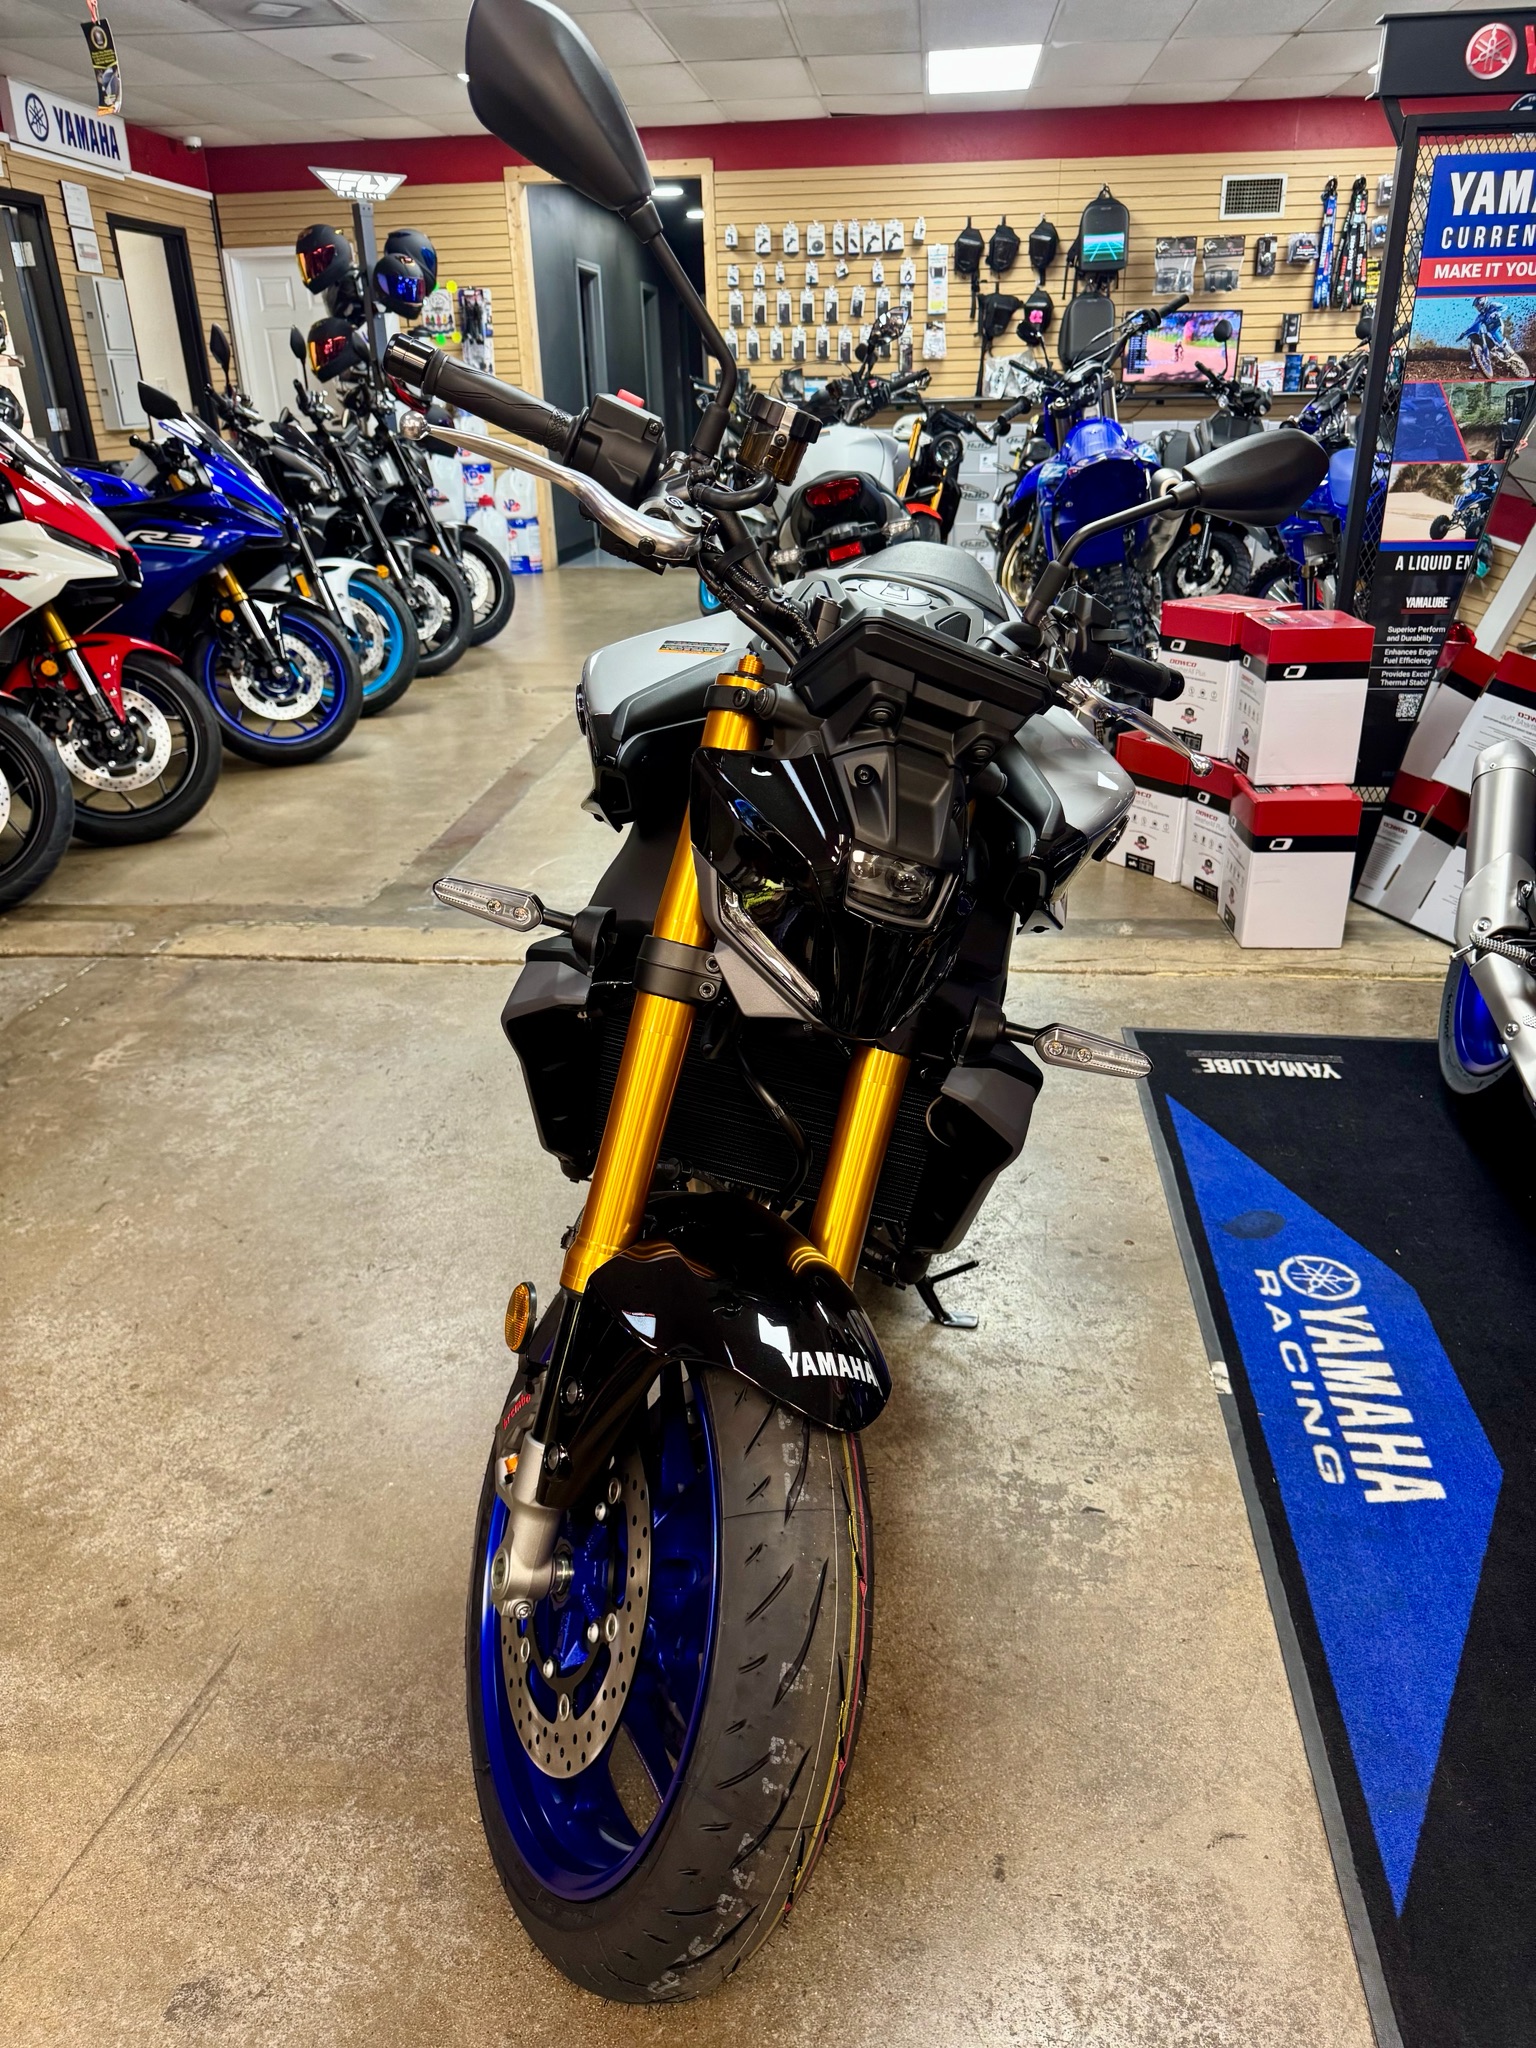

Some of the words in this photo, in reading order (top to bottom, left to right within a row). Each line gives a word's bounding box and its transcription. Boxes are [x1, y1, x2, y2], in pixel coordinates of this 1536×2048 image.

[52, 105, 121, 160] YAMAHA
[337, 190, 387, 200] RACING
[1450, 169, 1536, 216] YAM
[1441, 224, 1536, 249] CURREN
[1434, 263, 1482, 279] MAKE
[1485, 263, 1503, 277] IT
[1506, 261, 1536, 276] YOU
[125, 530, 205, 548] R3
[1395, 555, 1404, 571] A
[1408, 555, 1452, 571] LIQUID
[1406, 597, 1449, 608] YAMALUBE
[1386, 634, 1401, 642] and
[1401, 634, 1433, 643] Durability
[1387, 626, 1417, 635] Superior
[1384, 648, 1417, 656] Enhances
[1169, 658, 1197, 668] DOWCO
[1398, 657, 1432, 665] Efficiency
[1381, 670, 1410, 678] Provides
[1411, 670, 1431, 678] Excel
[1380, 679, 1408, 687] Thermal
[1195, 809, 1218, 822] DOWCO
[1198, 1058, 1342, 1080] YAMALUBE
[782, 1352, 879, 1388] YAMAHA
[1254, 1269, 1346, 1485] RACING
[503, 1393, 531, 1430] brembo
[1299, 1304, 1448, 1503] YAMAHA
